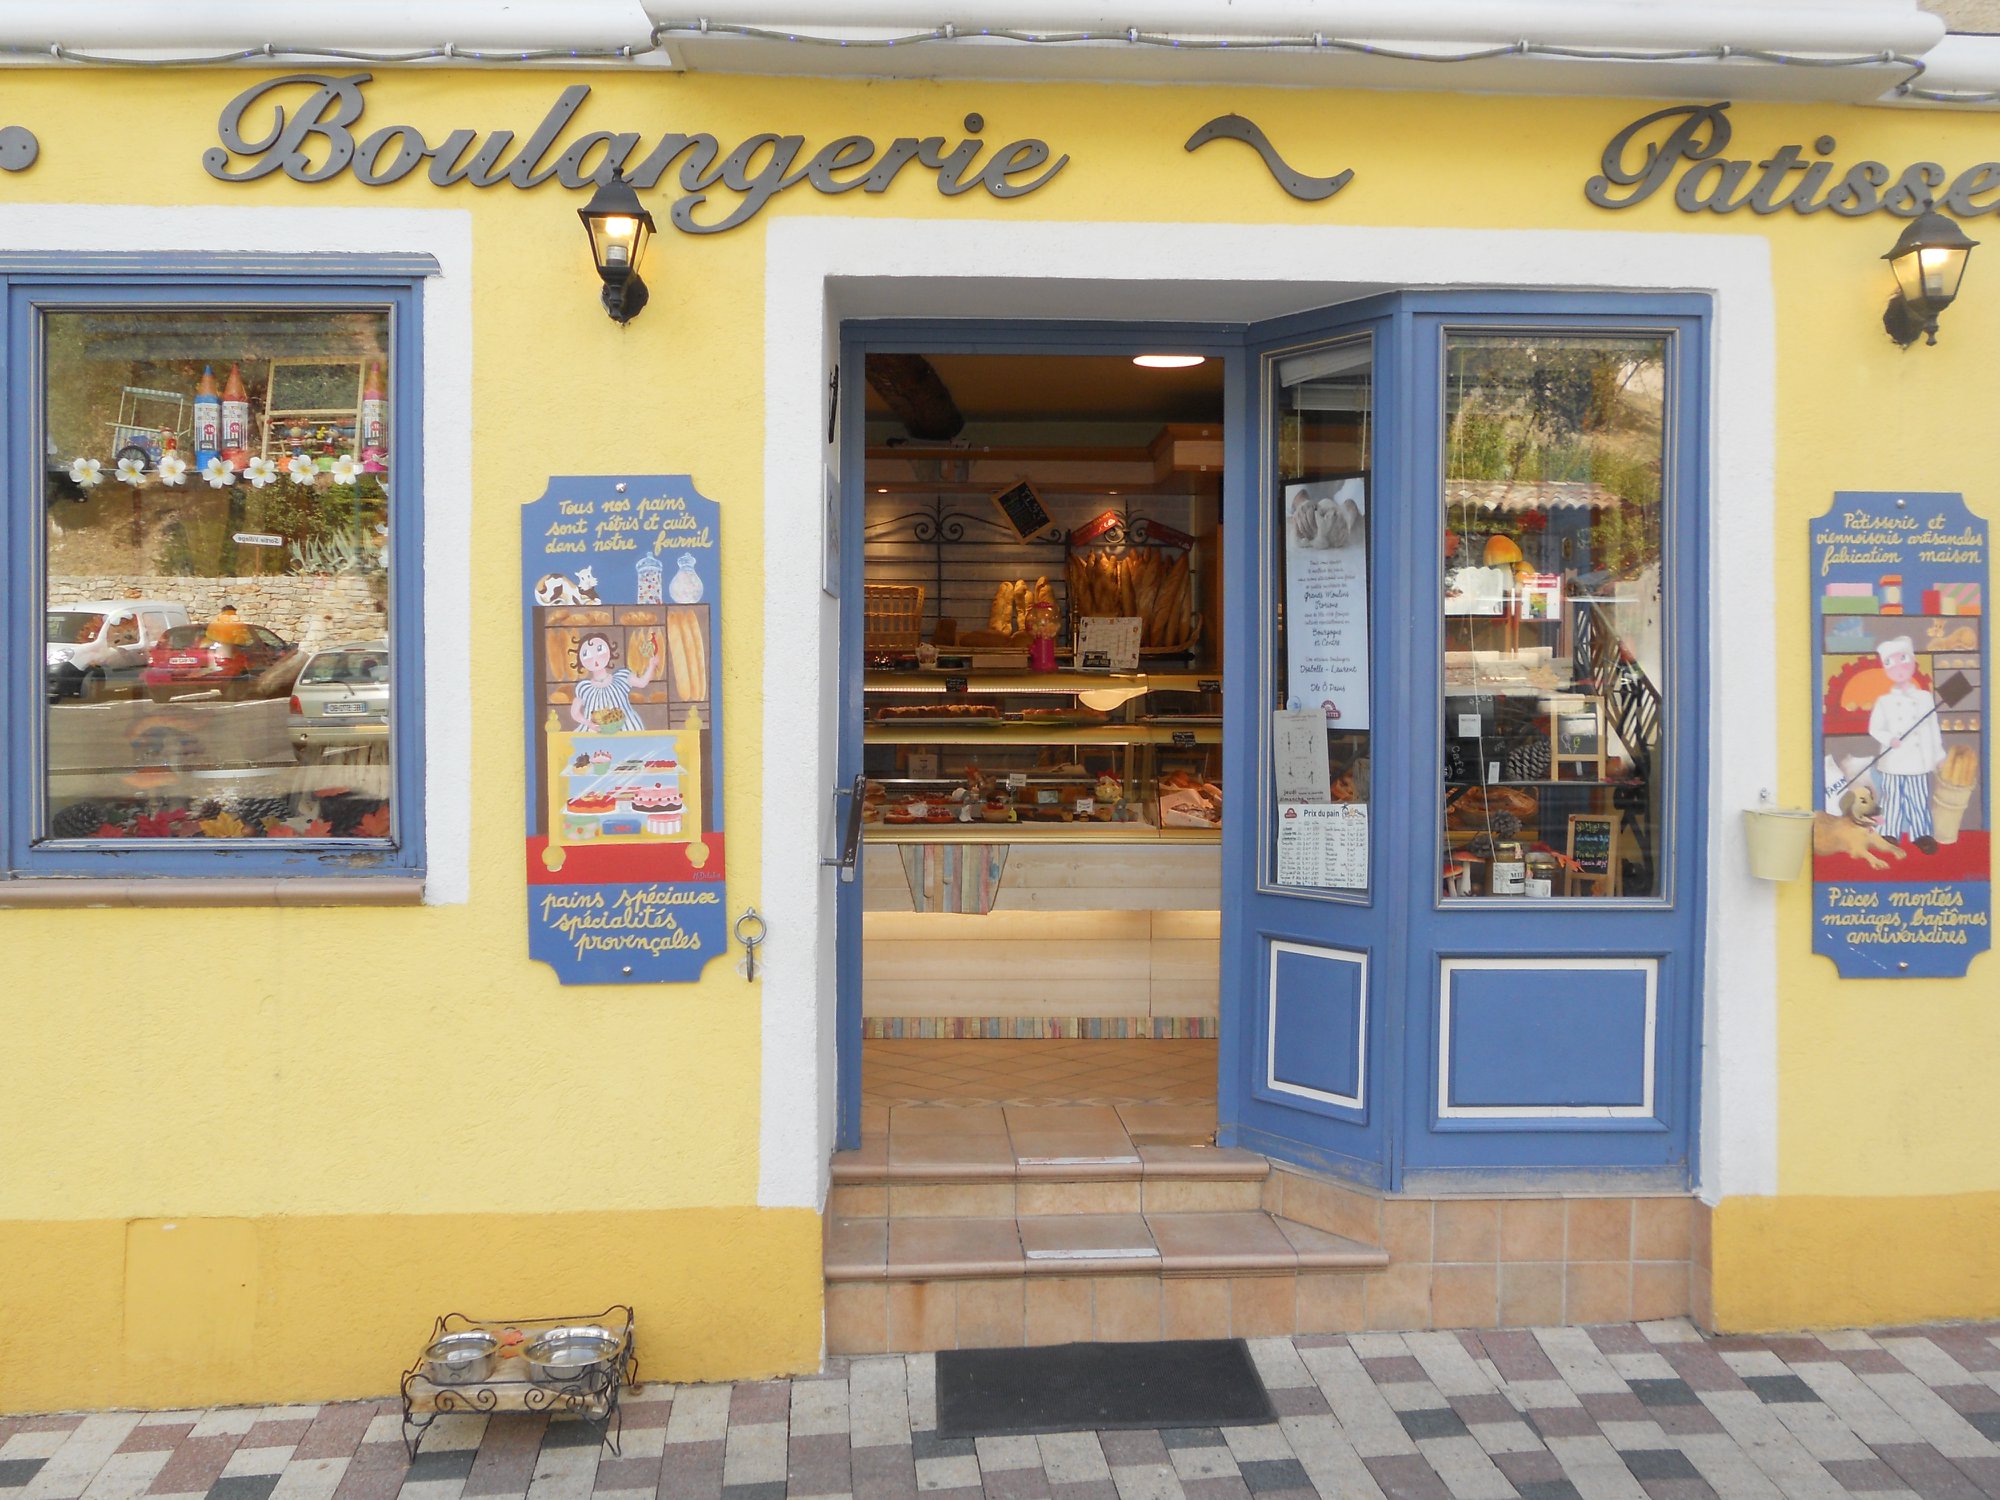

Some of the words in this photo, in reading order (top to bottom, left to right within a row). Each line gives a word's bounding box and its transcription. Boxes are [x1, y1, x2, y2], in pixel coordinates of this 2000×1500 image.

[203, 73, 1069, 234] Boulangerie
[559, 500, 594, 515] Tous
[601, 498, 630, 512] nos
[637, 494, 686, 519] pains
[545, 519, 588, 536] sont
[595, 514, 639, 537] pétris
[643, 515, 658, 530] et
[662, 513, 697, 530] cuits
[1843, 509, 1919, 530] Pâtisserie
[1928, 513, 1946, 530] et
[545, 538, 586, 553] dans
[593, 534, 637, 551] notre
[653, 527, 714, 556] fournil
[1816, 529, 1903, 545] viennoiserie
[1907, 527, 1983, 546] artisanales
[1821, 545, 1902, 577] fabrication
[1919, 547, 1982, 563] maison
[1303, 809, 1316, 817] Prix
[1318, 809, 1325, 817] du
[1326, 809, 1340, 818] pain
[540, 891, 605, 922] pains
[612, 884, 720, 913] spéciaux
[1828, 886, 1879, 907] Pièces
[1888, 885, 1964, 907] montées
[550, 906, 677, 941] spécialités
[1910, 908, 1987, 932] baptêmes
[574, 928, 701, 961] provençales
[1847, 927, 1967, 944] anniversaires
